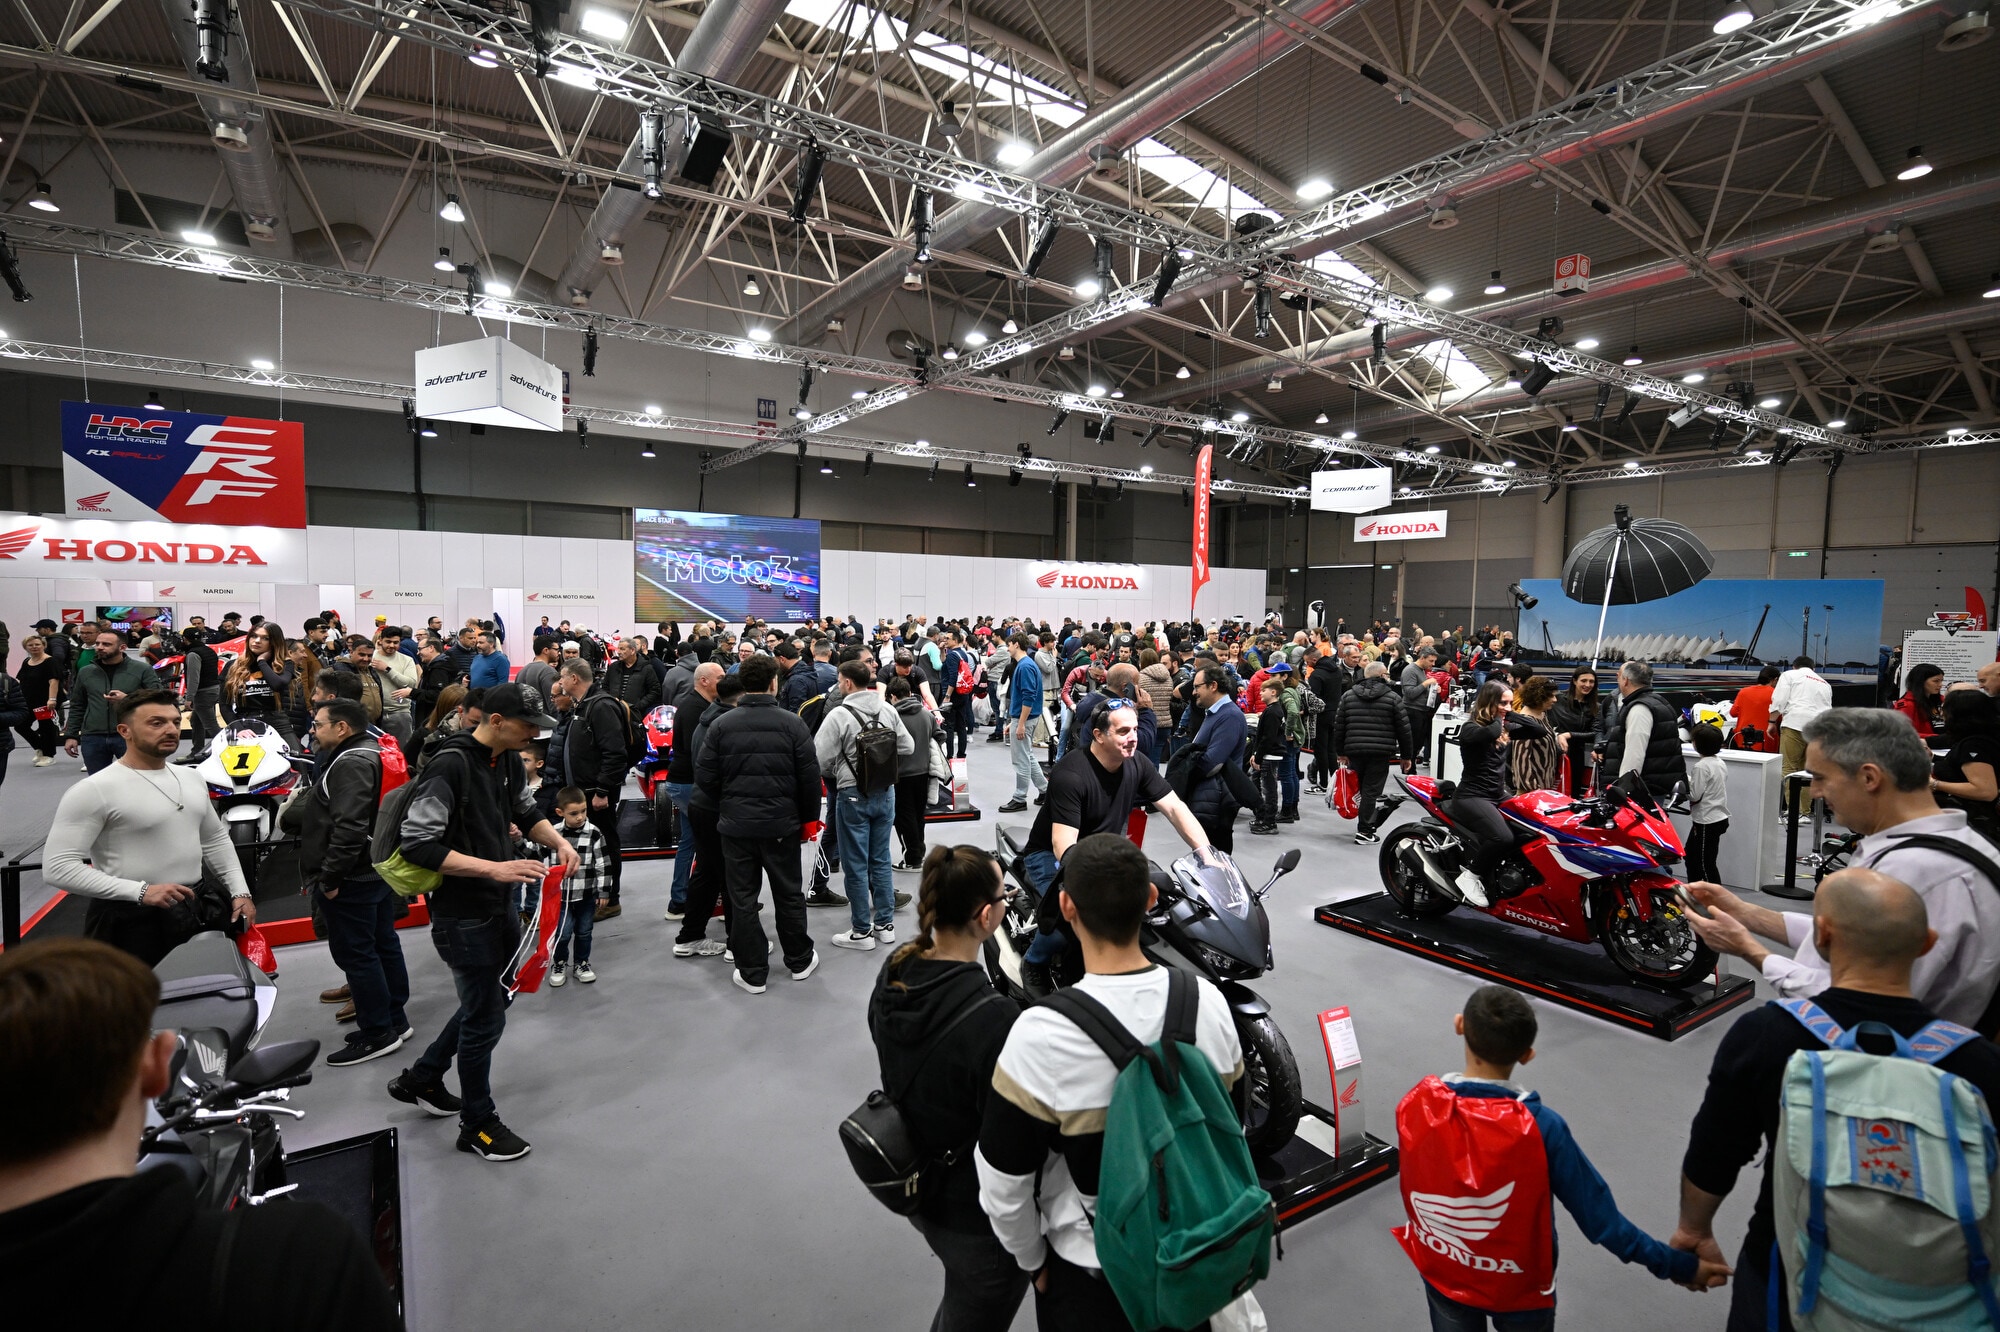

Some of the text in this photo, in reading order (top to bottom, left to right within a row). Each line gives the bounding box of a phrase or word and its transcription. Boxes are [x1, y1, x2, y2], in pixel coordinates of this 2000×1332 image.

[424, 369, 488, 387] adventure
[509, 373, 558, 402] adventure
[85, 413, 173, 440] HRC
[85, 434, 167, 445] Honda RACING
[86, 449, 111, 457] RX
[1322, 484, 1380, 493] commuter
[1198, 452, 1208, 551] HONDA
[1376, 522, 1440, 536] HONDA
[43, 538, 268, 566] HONDA
[1060, 575, 1139, 590] HONDA
[233, 752, 250, 770] 1
[1505, 909, 1561, 932] HONDA
[1412, 1219, 1524, 1273] HONDA
